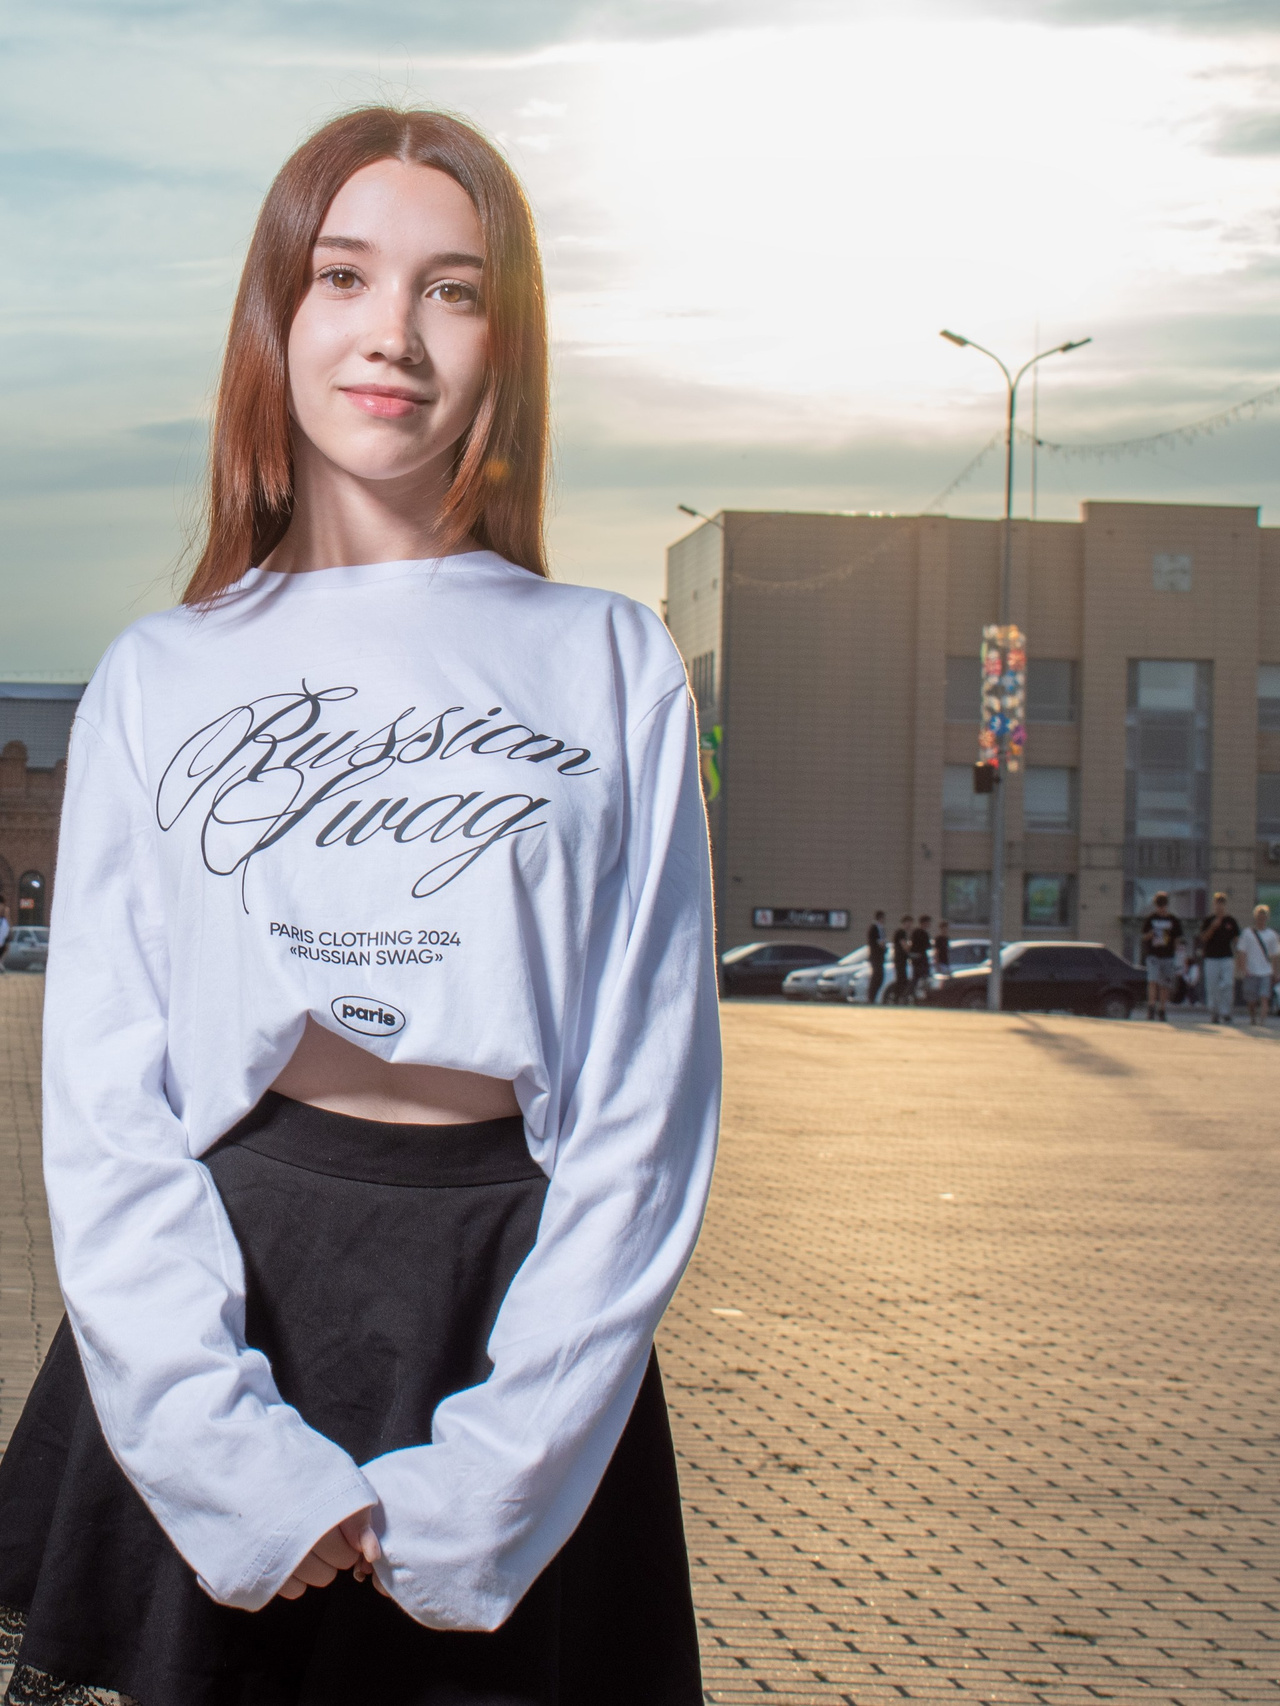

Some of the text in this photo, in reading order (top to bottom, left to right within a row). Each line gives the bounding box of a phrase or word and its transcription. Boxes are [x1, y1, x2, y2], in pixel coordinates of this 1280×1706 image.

[156, 678, 601, 832] Russian
[201, 756, 552, 914] Swag
[270, 922, 461, 947] PARIS CLOTHING 2024
[290, 945, 443, 966] «RUSSIAN SWAG»
[342, 1003, 396, 1027] paris
